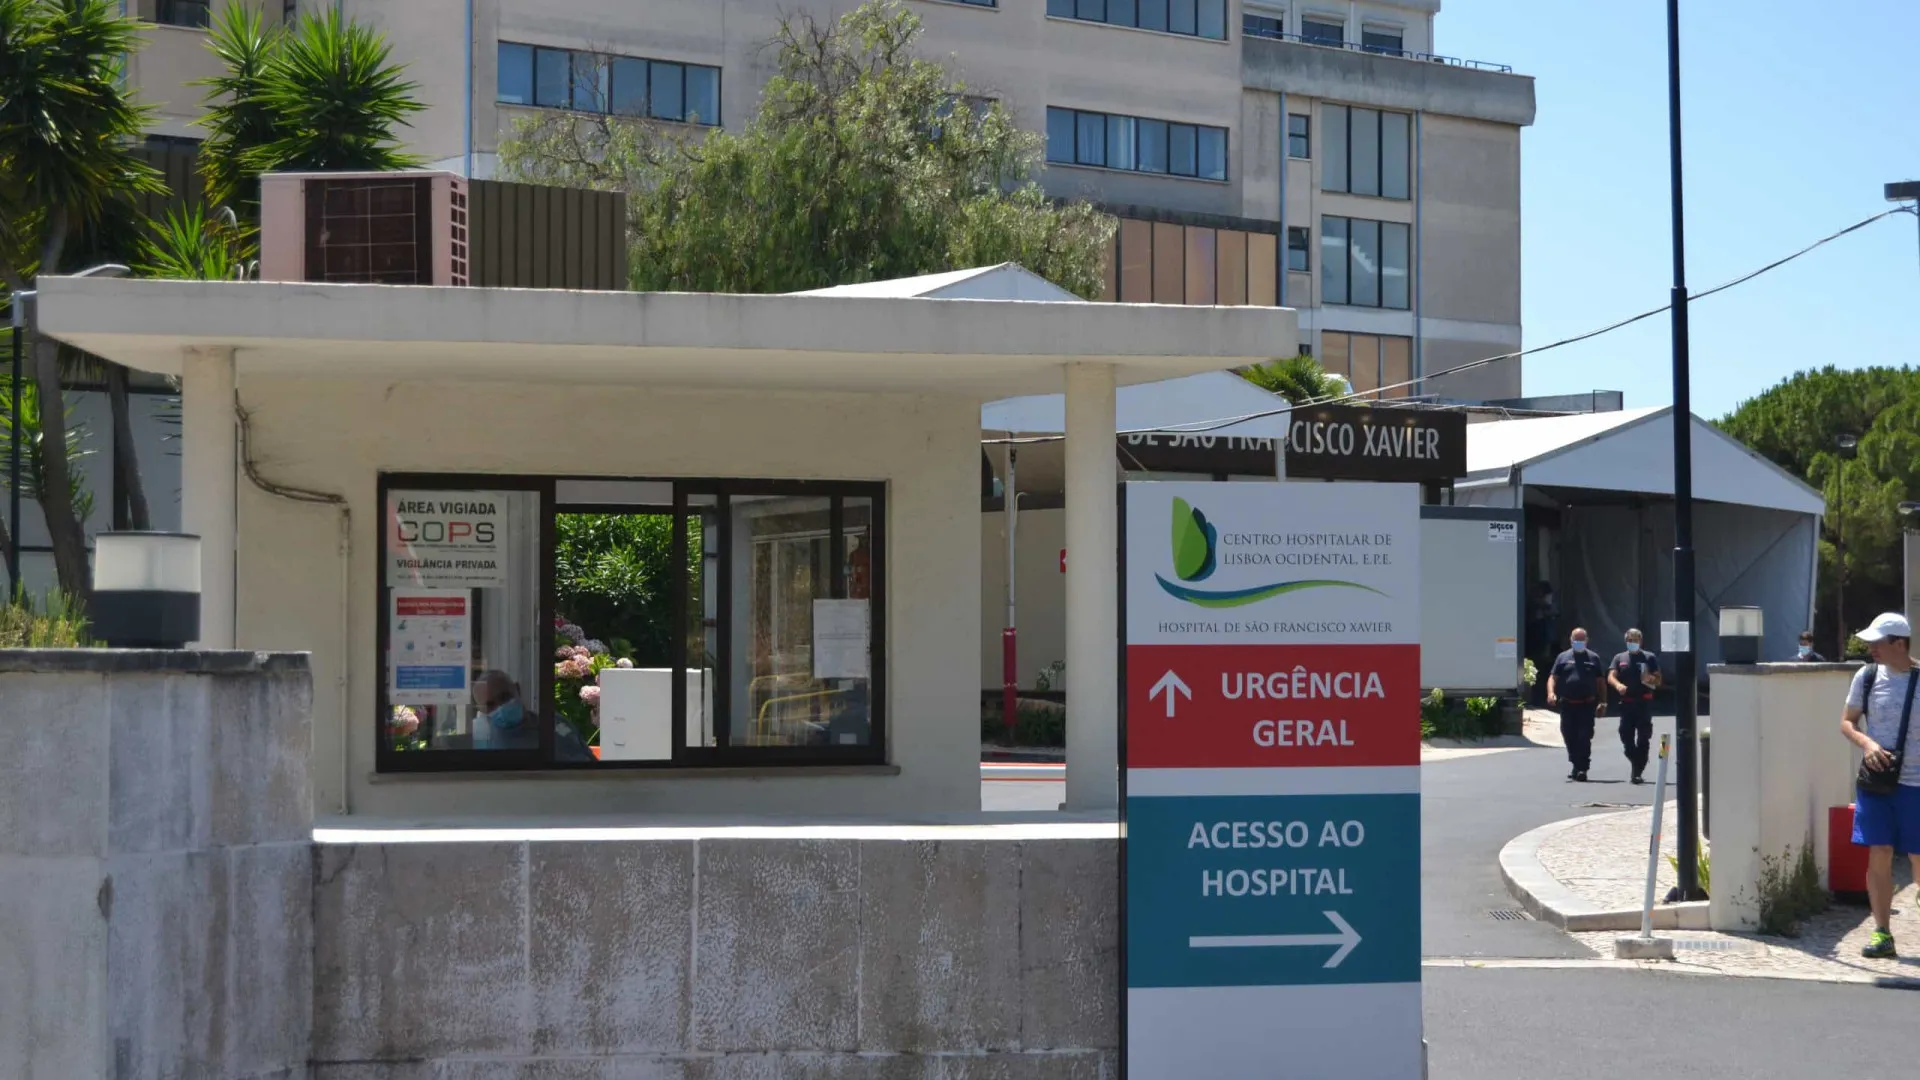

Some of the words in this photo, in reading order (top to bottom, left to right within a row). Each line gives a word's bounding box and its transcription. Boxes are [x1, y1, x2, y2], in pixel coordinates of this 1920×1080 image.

[1362, 424, 1440, 460] XAVIER
[396, 498, 435, 515] ÁREA
[439, 501, 497, 516] VIGIADA
[398, 520, 496, 544] COPS
[1223, 533, 1282, 546] CENTRO
[1286, 533, 1370, 547] HOSPITALAR
[1374, 533, 1393, 546] DE
[397, 557, 453, 570] VIGILÂNCIA
[455, 560, 498, 570] PRIVADA
[1223, 553, 1272, 565] LISBOA
[1275, 553, 1359, 567] OCIDENTAL,
[1158, 622, 1220, 633] HOSPITAL
[1224, 622, 1241, 633] DE
[1244, 620, 1270, 633] SÃO
[1274, 622, 1347, 633] FRANCISCO
[1350, 622, 1393, 633] XAVIER
[1221, 665, 1385, 700] URGÊNCIA
[1252, 719, 1355, 747] GERAL
[1187, 820, 1309, 849] ACESSO
[1318, 819, 1365, 848] AO
[1202, 867, 1354, 897] HOSPITAL
